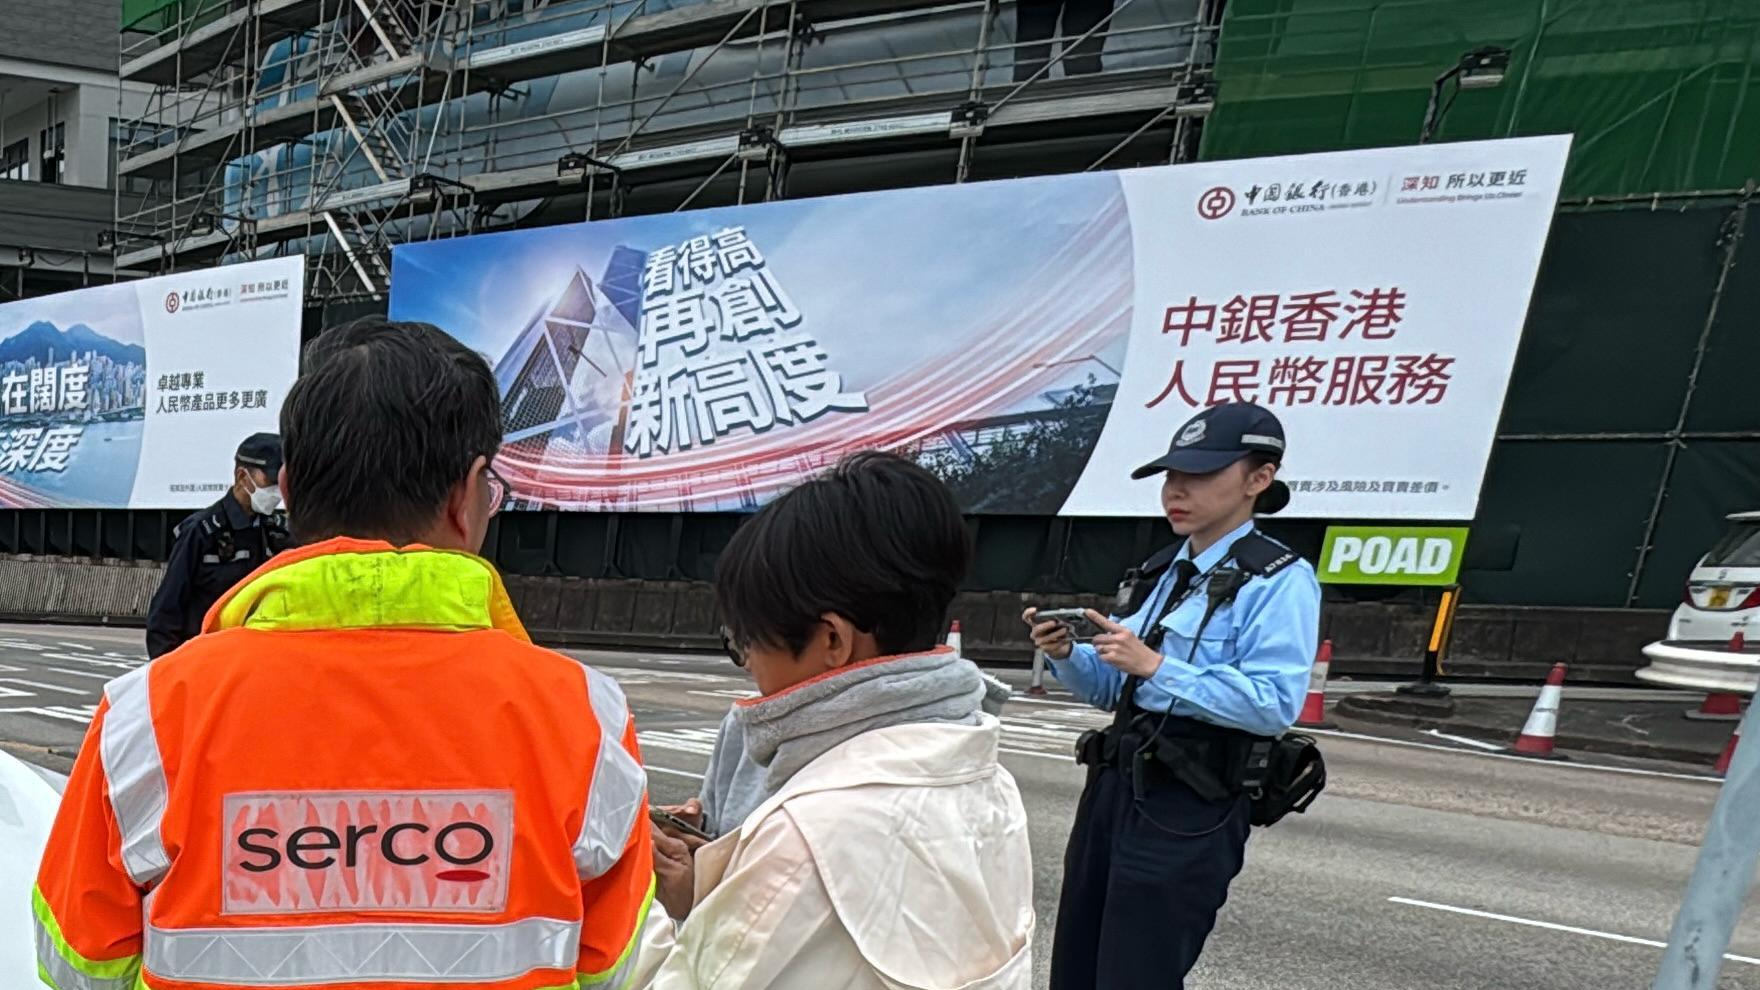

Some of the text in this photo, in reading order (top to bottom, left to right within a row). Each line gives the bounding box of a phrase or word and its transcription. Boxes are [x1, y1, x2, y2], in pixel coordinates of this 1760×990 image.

[1401, 169, 1528, 192] 深知 所以更近
[1240, 207, 1270, 217] BANK
[1272, 206, 1287, 215] OF
[1289, 203, 1325, 213] CHINA
[642, 226, 765, 298] 看得高
[639, 268, 802, 368] 再創
[1161, 287, 1406, 347] 中銀香港
[157, 371, 204, 392] 卓越專業
[624, 334, 870, 458] 新高度
[1144, 353, 1456, 409] 人民幣服務
[1327, 535, 1453, 575] POAD
[237, 821, 494, 873] serco
